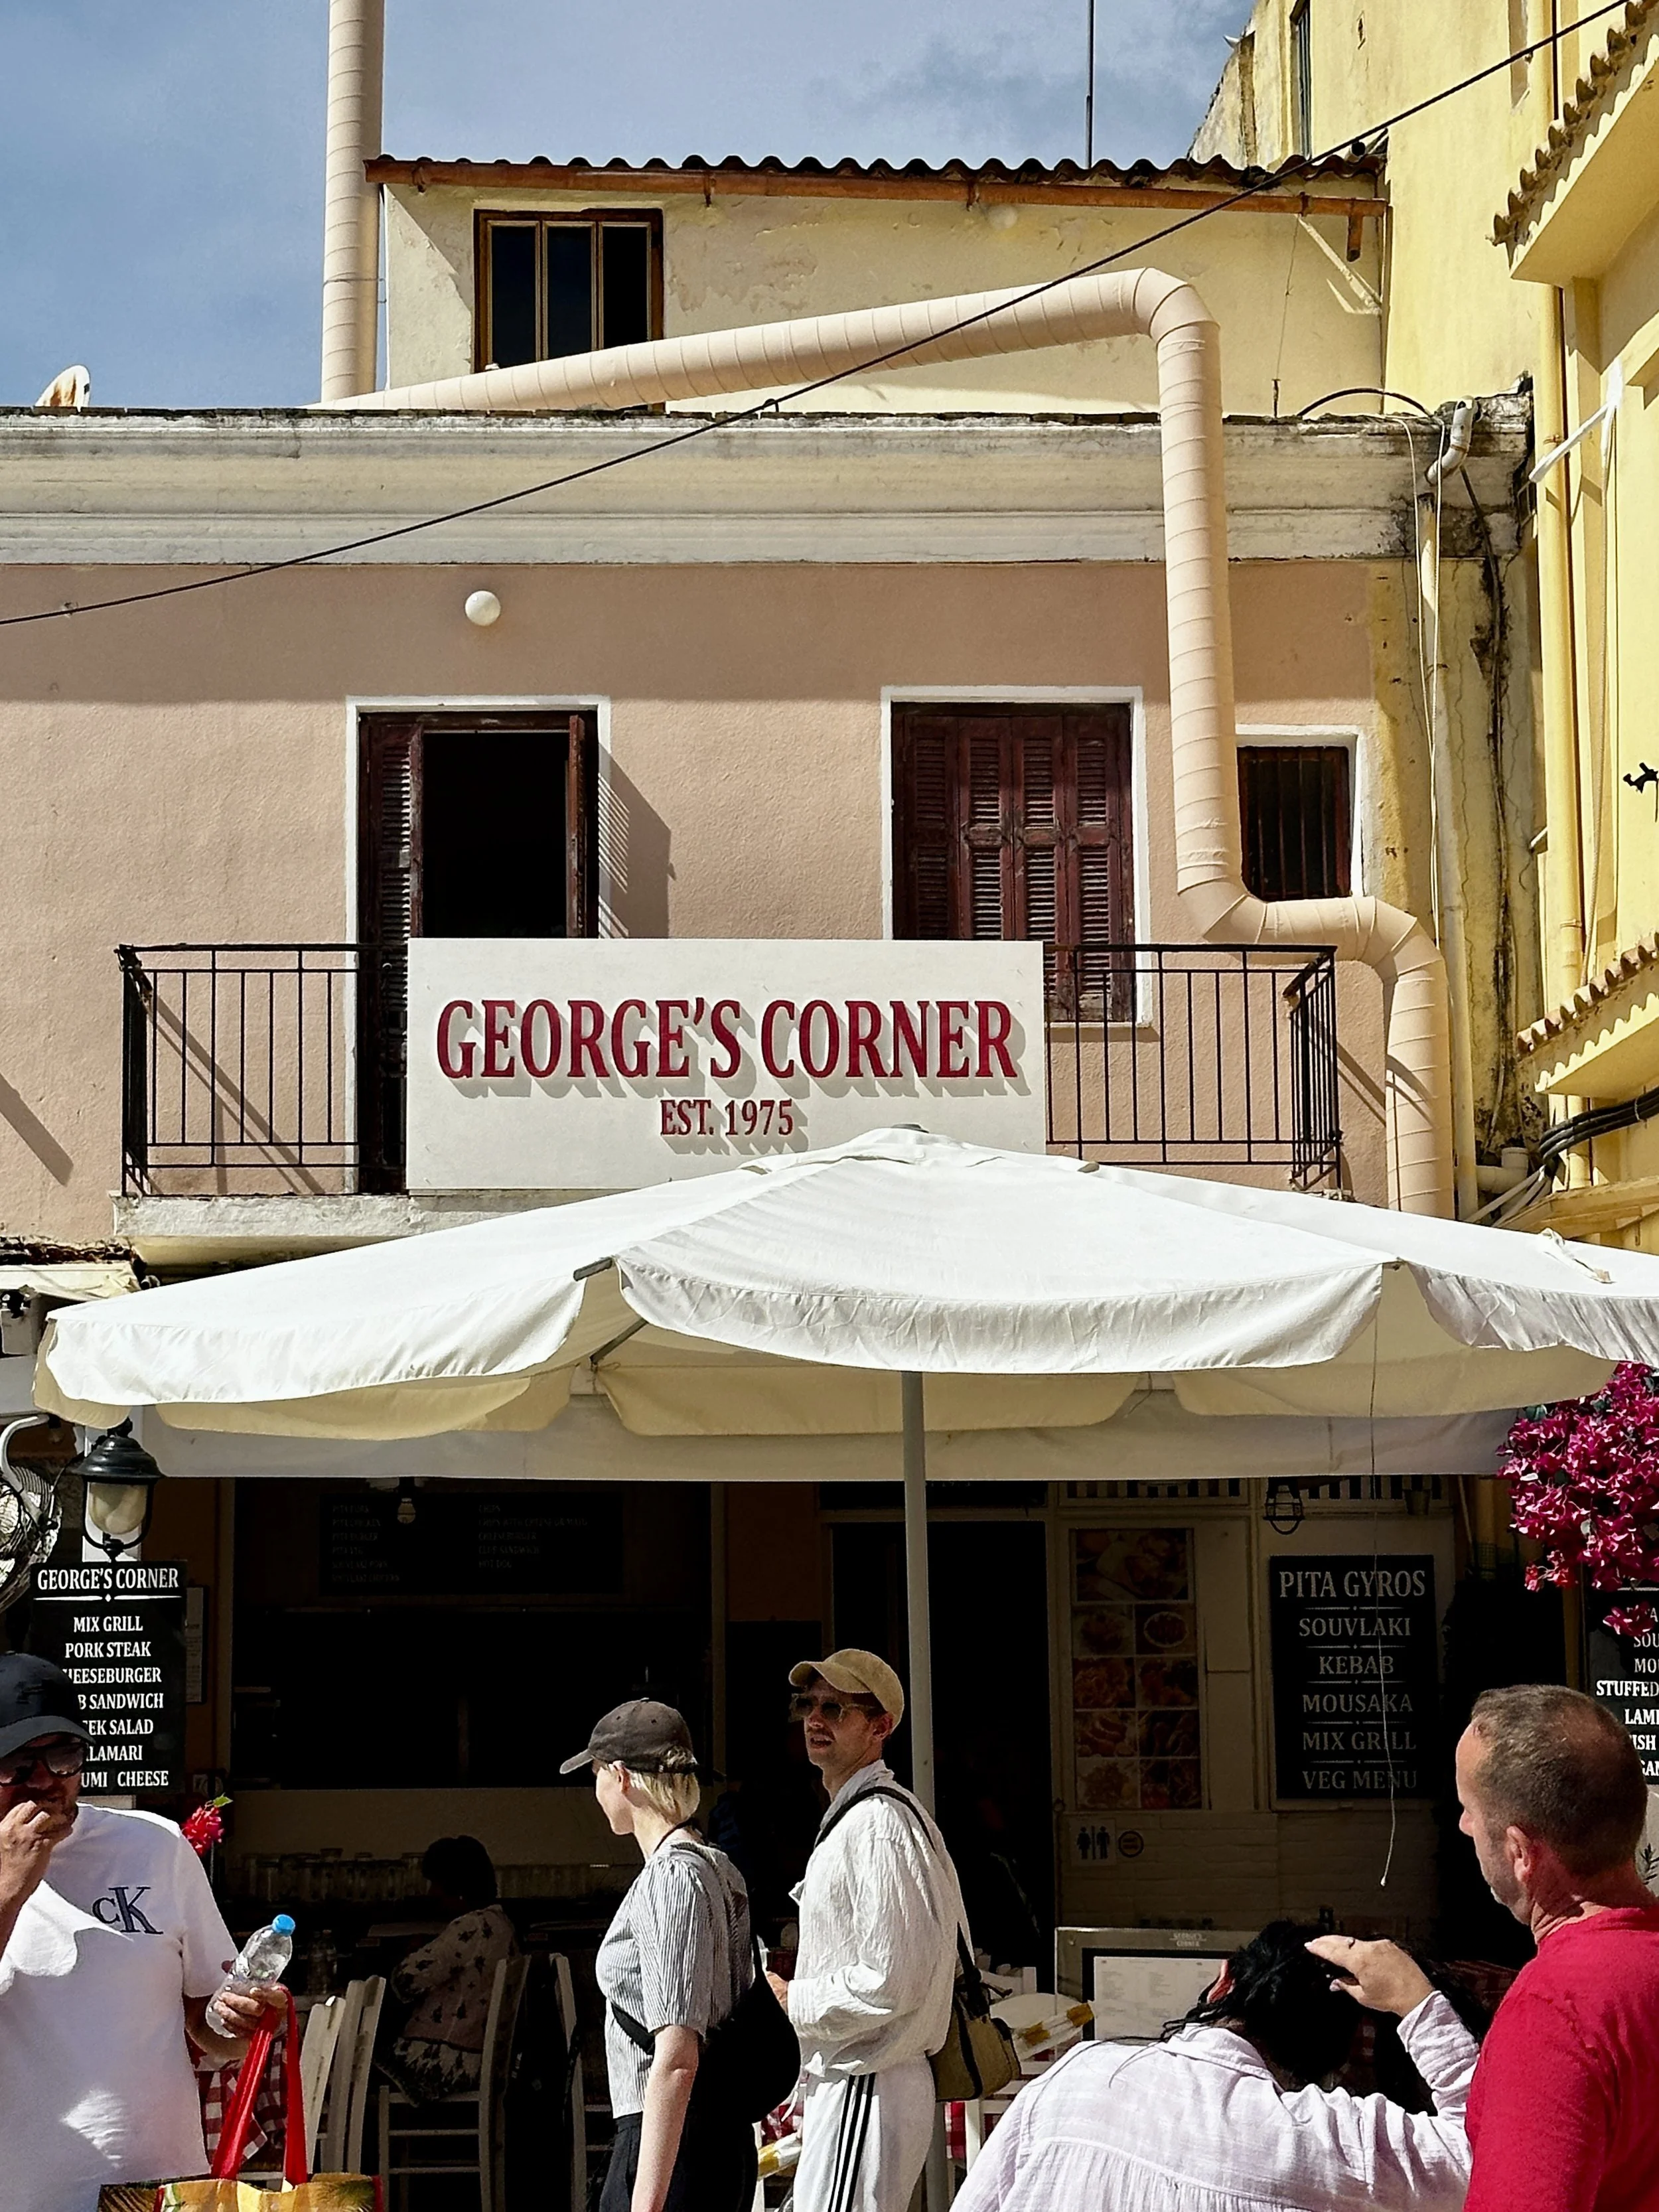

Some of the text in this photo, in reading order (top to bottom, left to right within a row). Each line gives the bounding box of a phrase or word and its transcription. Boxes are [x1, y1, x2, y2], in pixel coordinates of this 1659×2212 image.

[437, 997, 1018, 1079] GEORGE'S CORNER
[660, 1099, 794, 1136] EST. 1975
[37, 1568, 179, 1590] GEORGE'S CORNER
[1279, 1570, 1426, 1598] PITA GYROS
[74, 1615, 143, 1633] MIX GRILL
[1299, 1618, 1411, 1637] SOUVLAKI
[66, 1641, 152, 1659] PORK STEAK
[1319, 1655, 1394, 1674] KEBAB
[1596, 1680, 1659, 1697] STUFFED
[89, 1692, 164, 1710] SANDWICH
[1303, 1694, 1413, 1713] MOUSAKA
[109, 1719, 154, 1735] SALAD
[1303, 1731, 1416, 1751] MIX GRILL
[86, 1745, 143, 1762] LAMARI
[117, 1771, 169, 1787] CHEESE
[1302, 1770, 1417, 1790] VEG MENU
